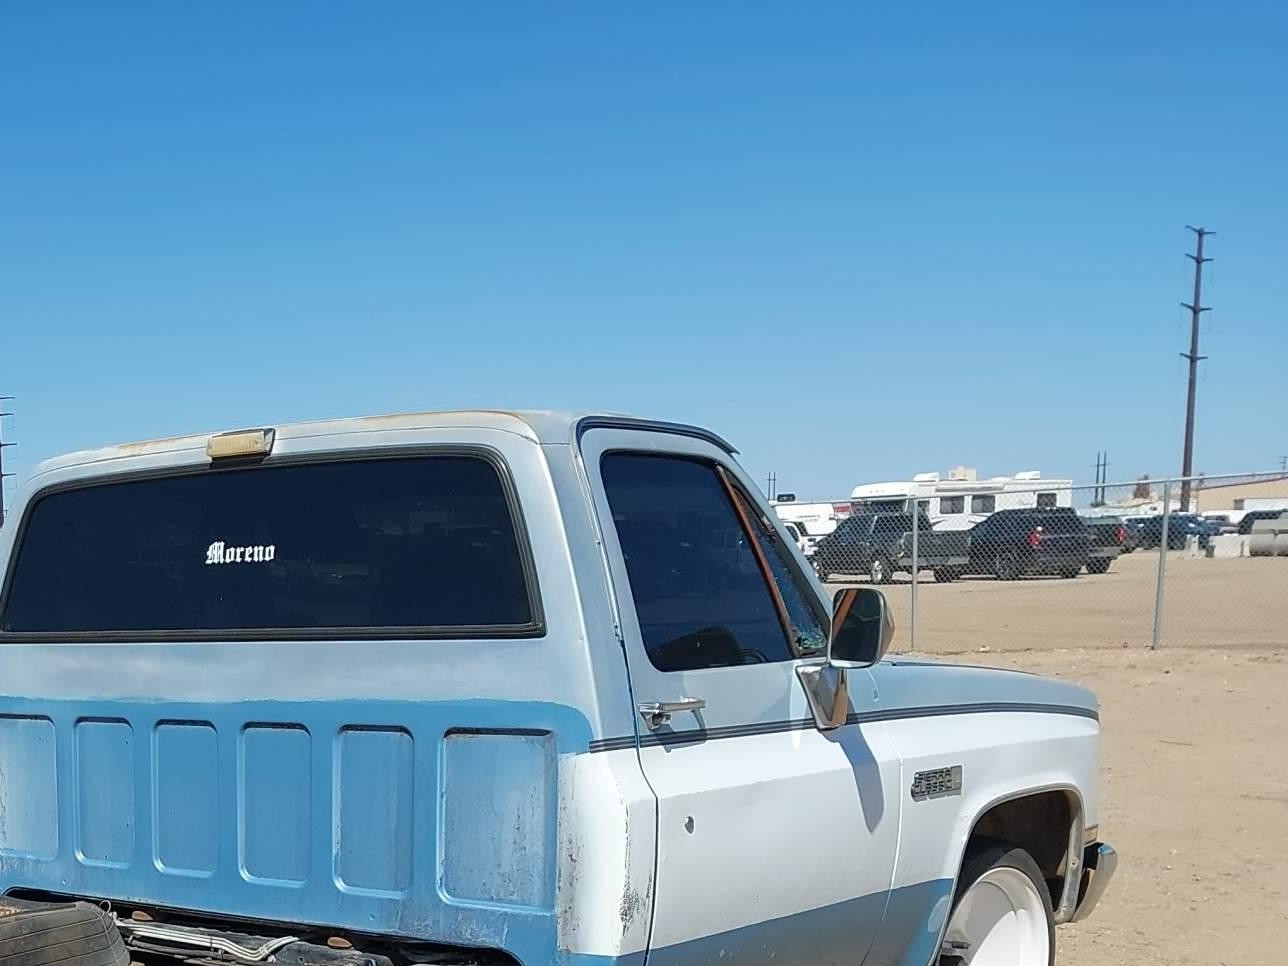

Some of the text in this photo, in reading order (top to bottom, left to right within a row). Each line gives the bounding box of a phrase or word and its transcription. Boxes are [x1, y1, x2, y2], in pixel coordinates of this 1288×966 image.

[205, 541, 275, 564] Moreno
[914, 768, 952, 785] SIERRA
[912, 779, 953, 796] CLASSIC
